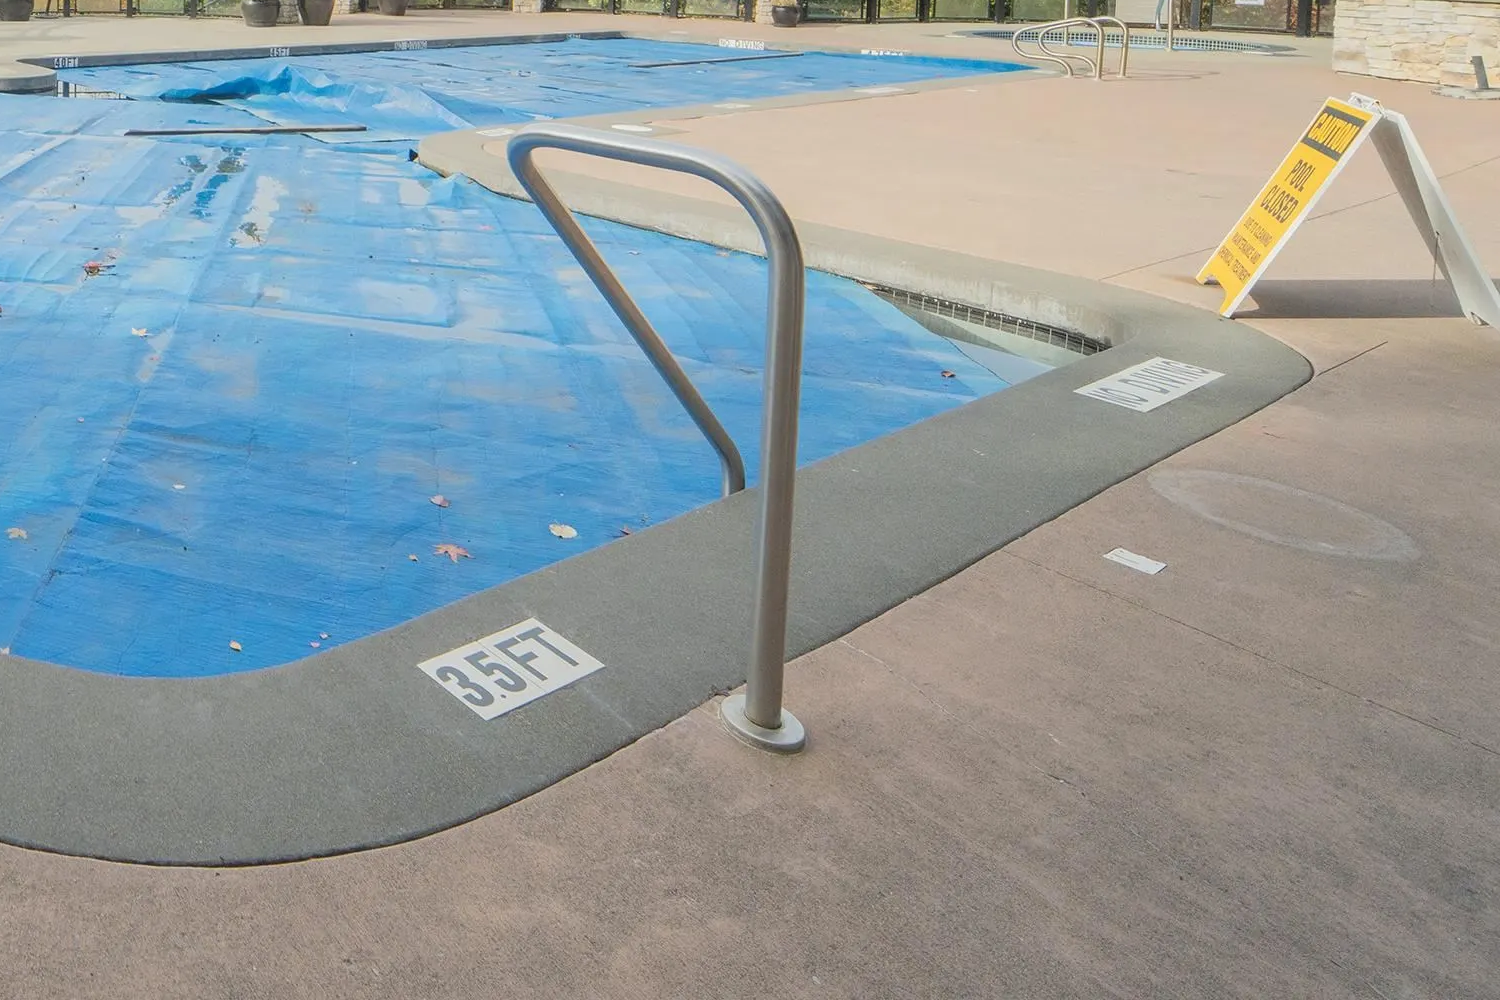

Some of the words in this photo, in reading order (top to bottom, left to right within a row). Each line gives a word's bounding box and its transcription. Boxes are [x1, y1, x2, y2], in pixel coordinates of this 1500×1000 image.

[1307, 112, 1361, 154] CAUTION
[1284, 159, 1316, 193] POOL
[1260, 184, 1299, 224] CLOSED
[1117, 360, 1210, 395] DIVING
[1086, 387, 1149, 409] NO
